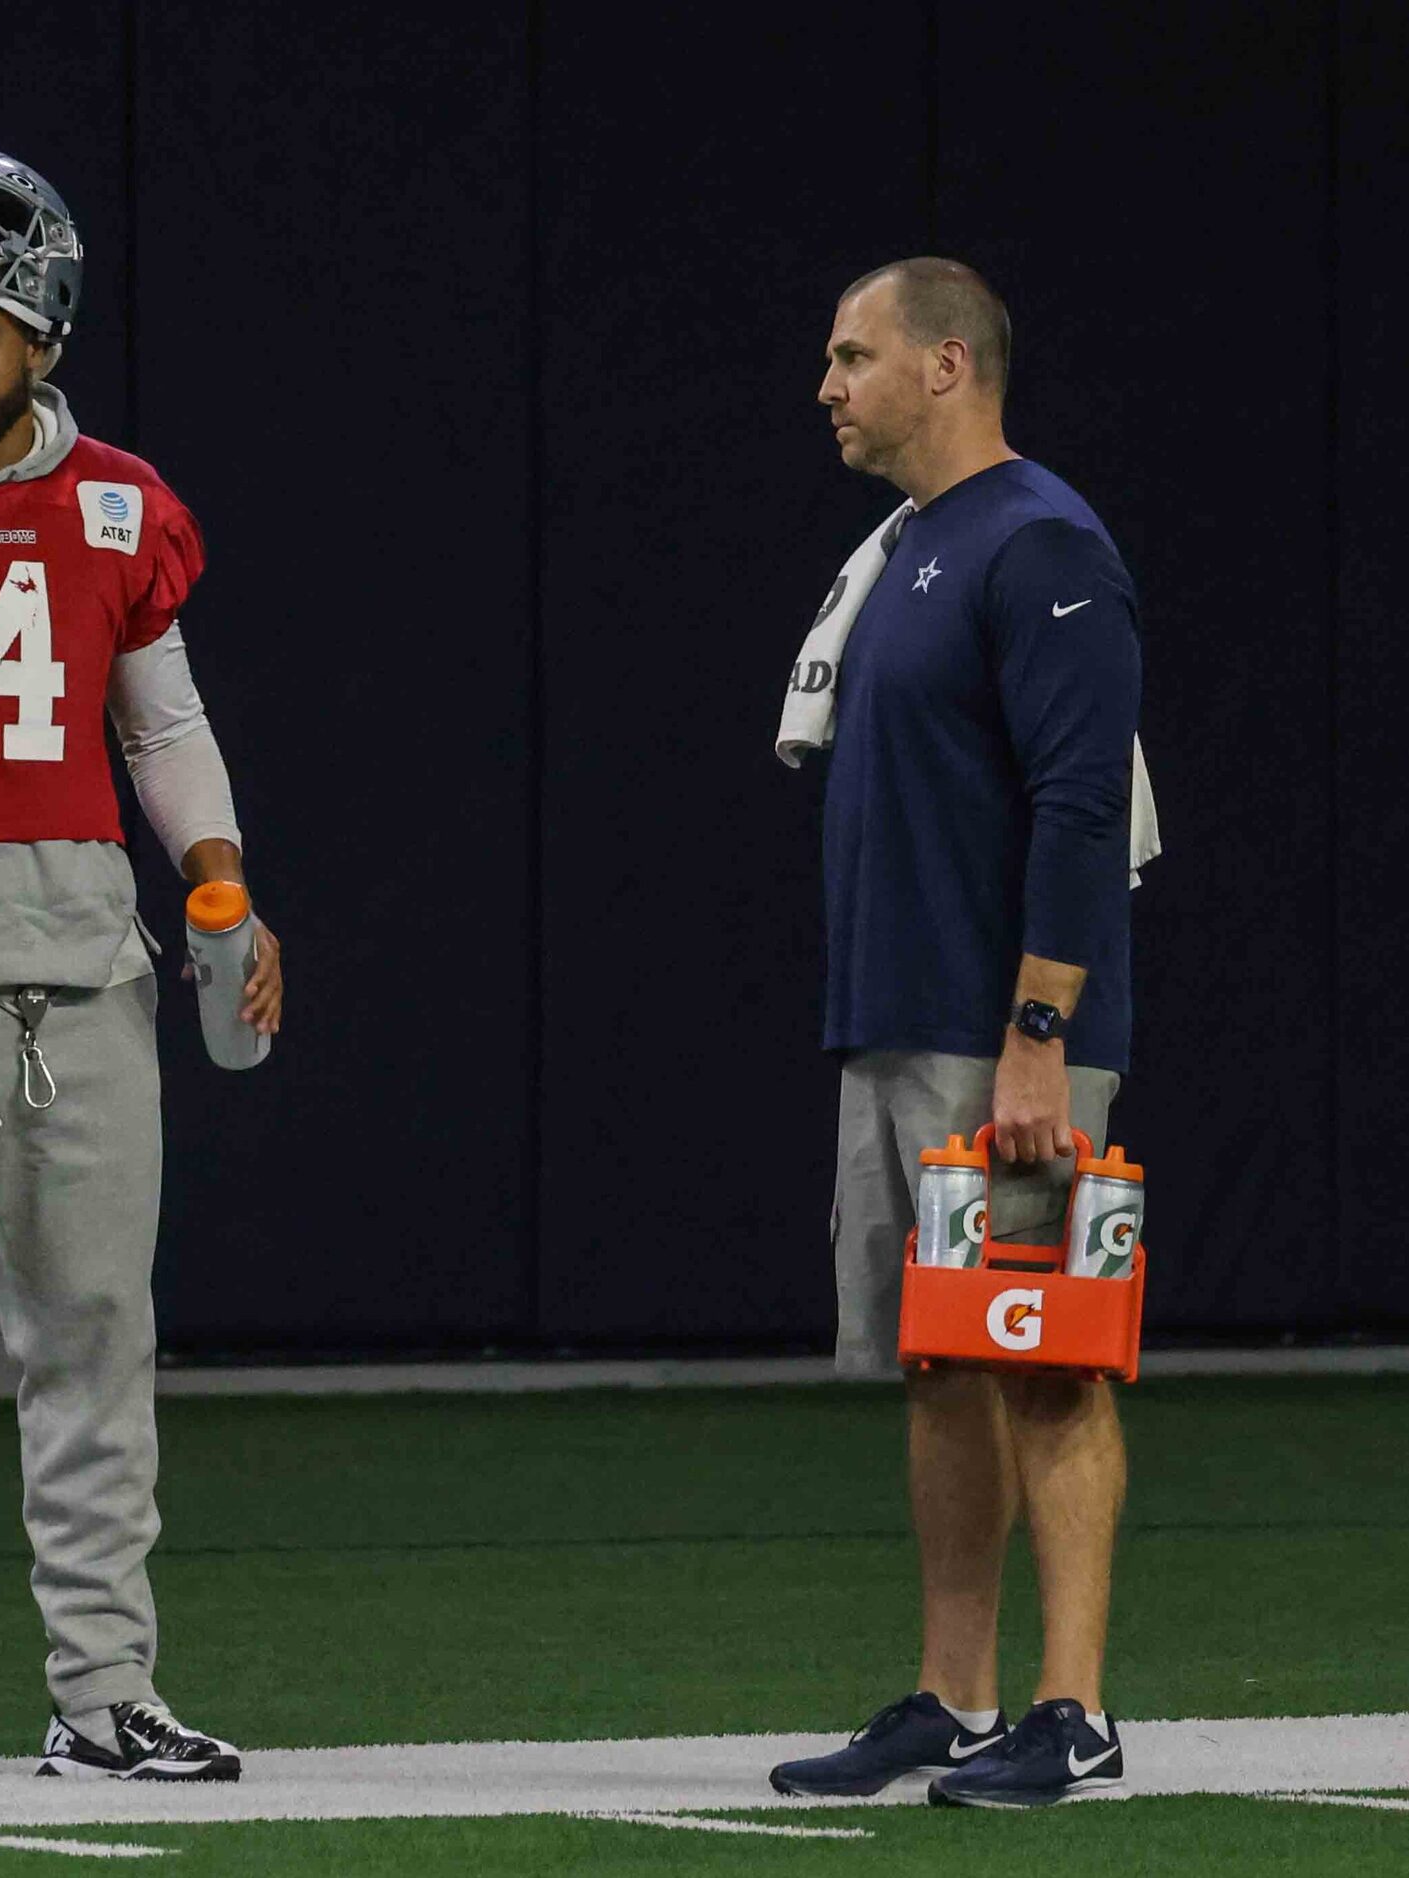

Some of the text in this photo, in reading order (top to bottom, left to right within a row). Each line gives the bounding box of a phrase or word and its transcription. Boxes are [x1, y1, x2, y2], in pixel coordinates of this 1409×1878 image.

[100, 526, 133, 544] AT&T
[1100, 1212, 1137, 1257] G
[986, 1288, 1045, 1351] G
